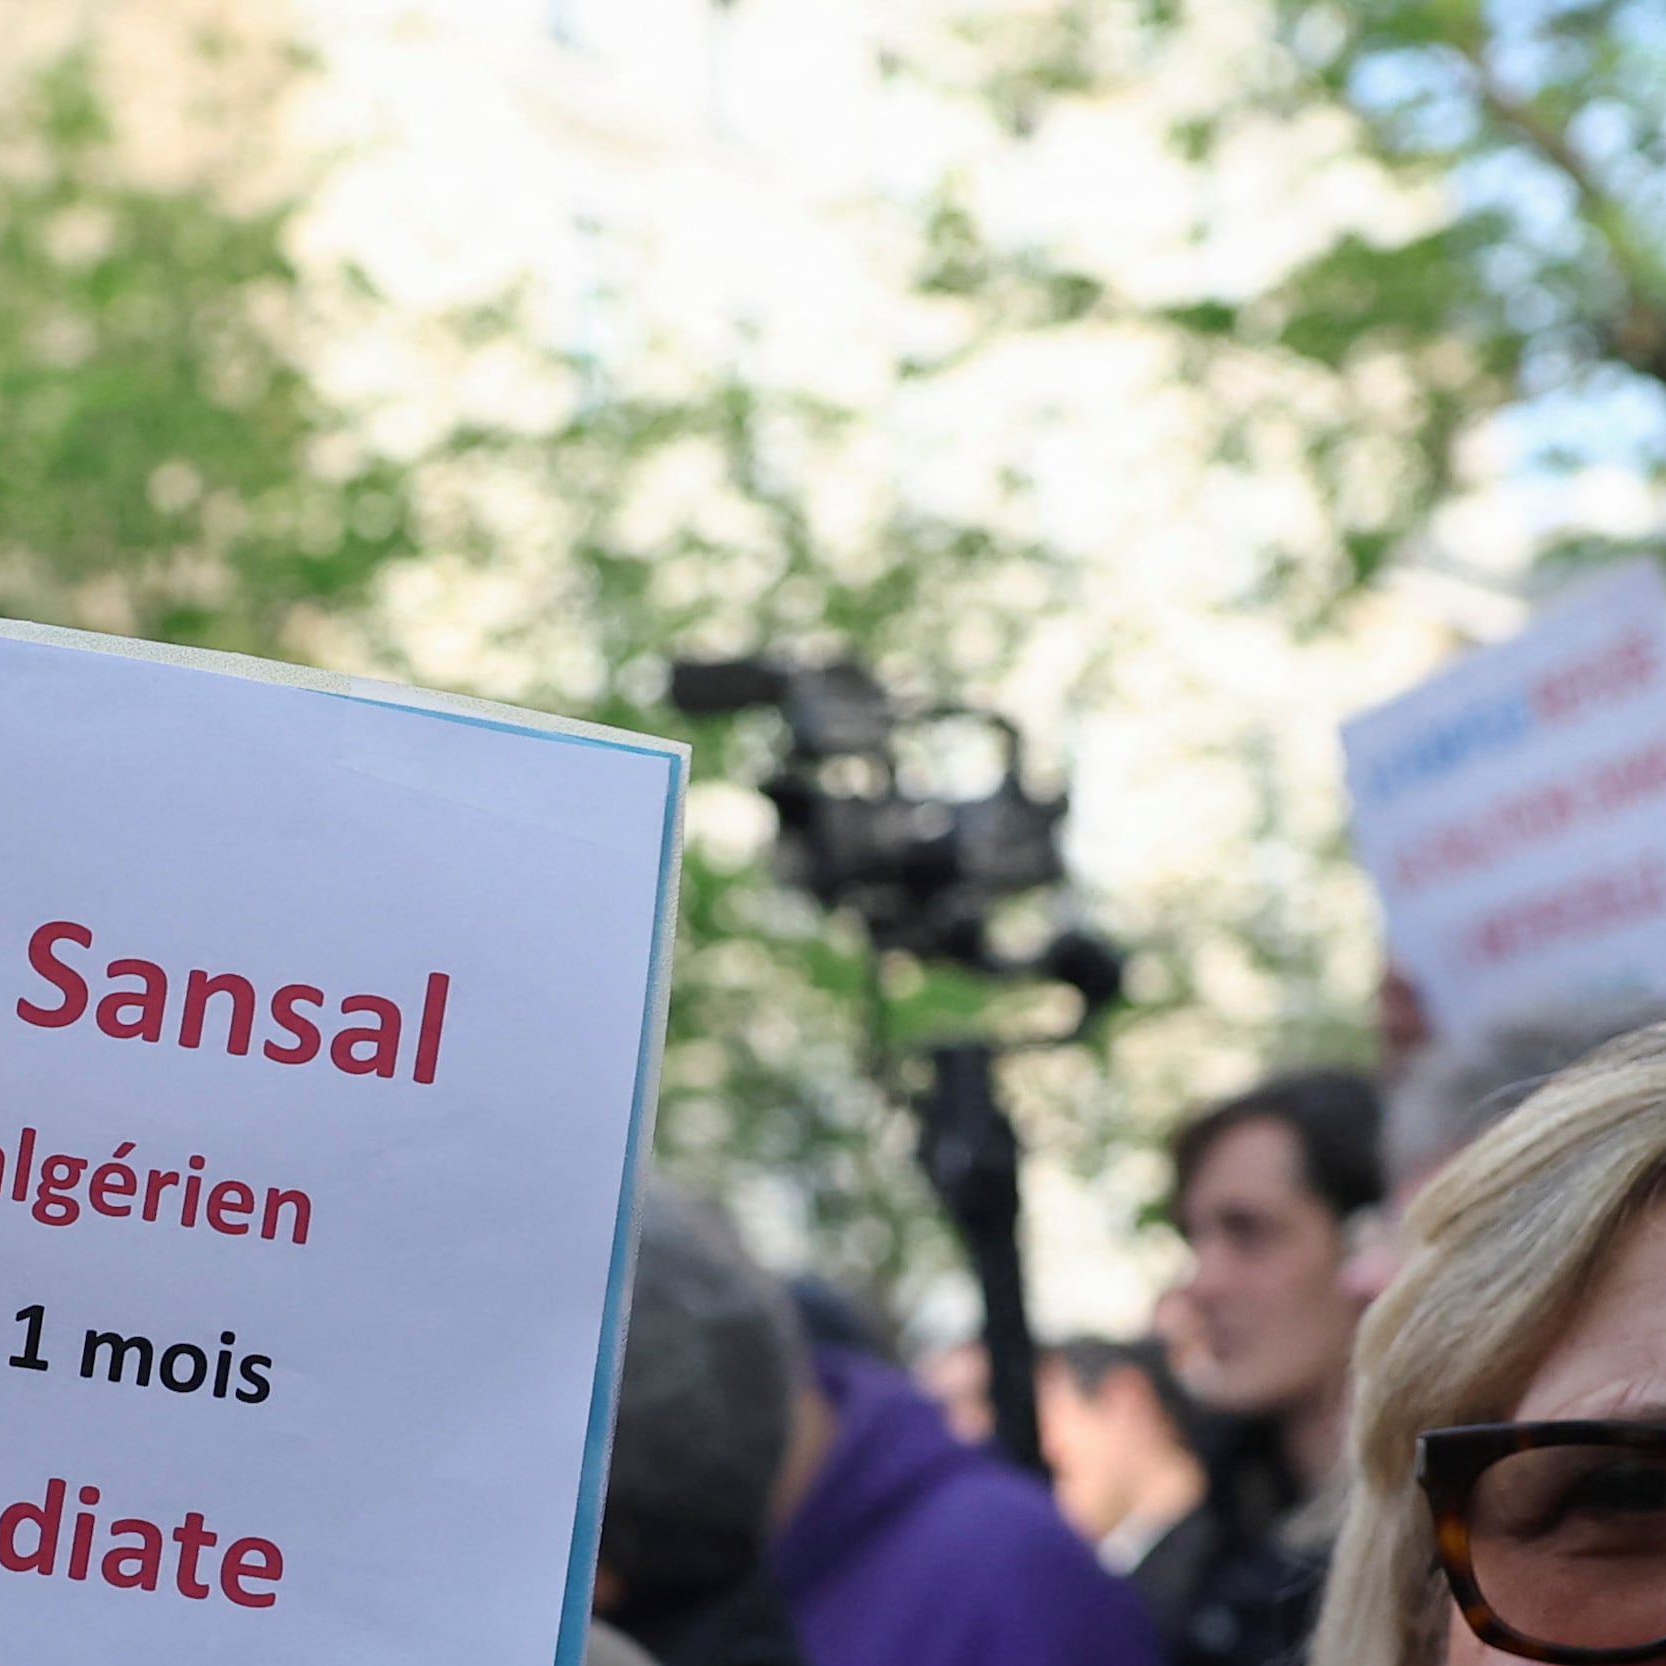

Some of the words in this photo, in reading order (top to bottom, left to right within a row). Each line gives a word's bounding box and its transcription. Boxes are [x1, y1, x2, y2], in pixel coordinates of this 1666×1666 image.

[16, 921, 450, 1084] Sansal
[9, 1305, 48, 1371] 1
[80, 1330, 272, 1403] mois
